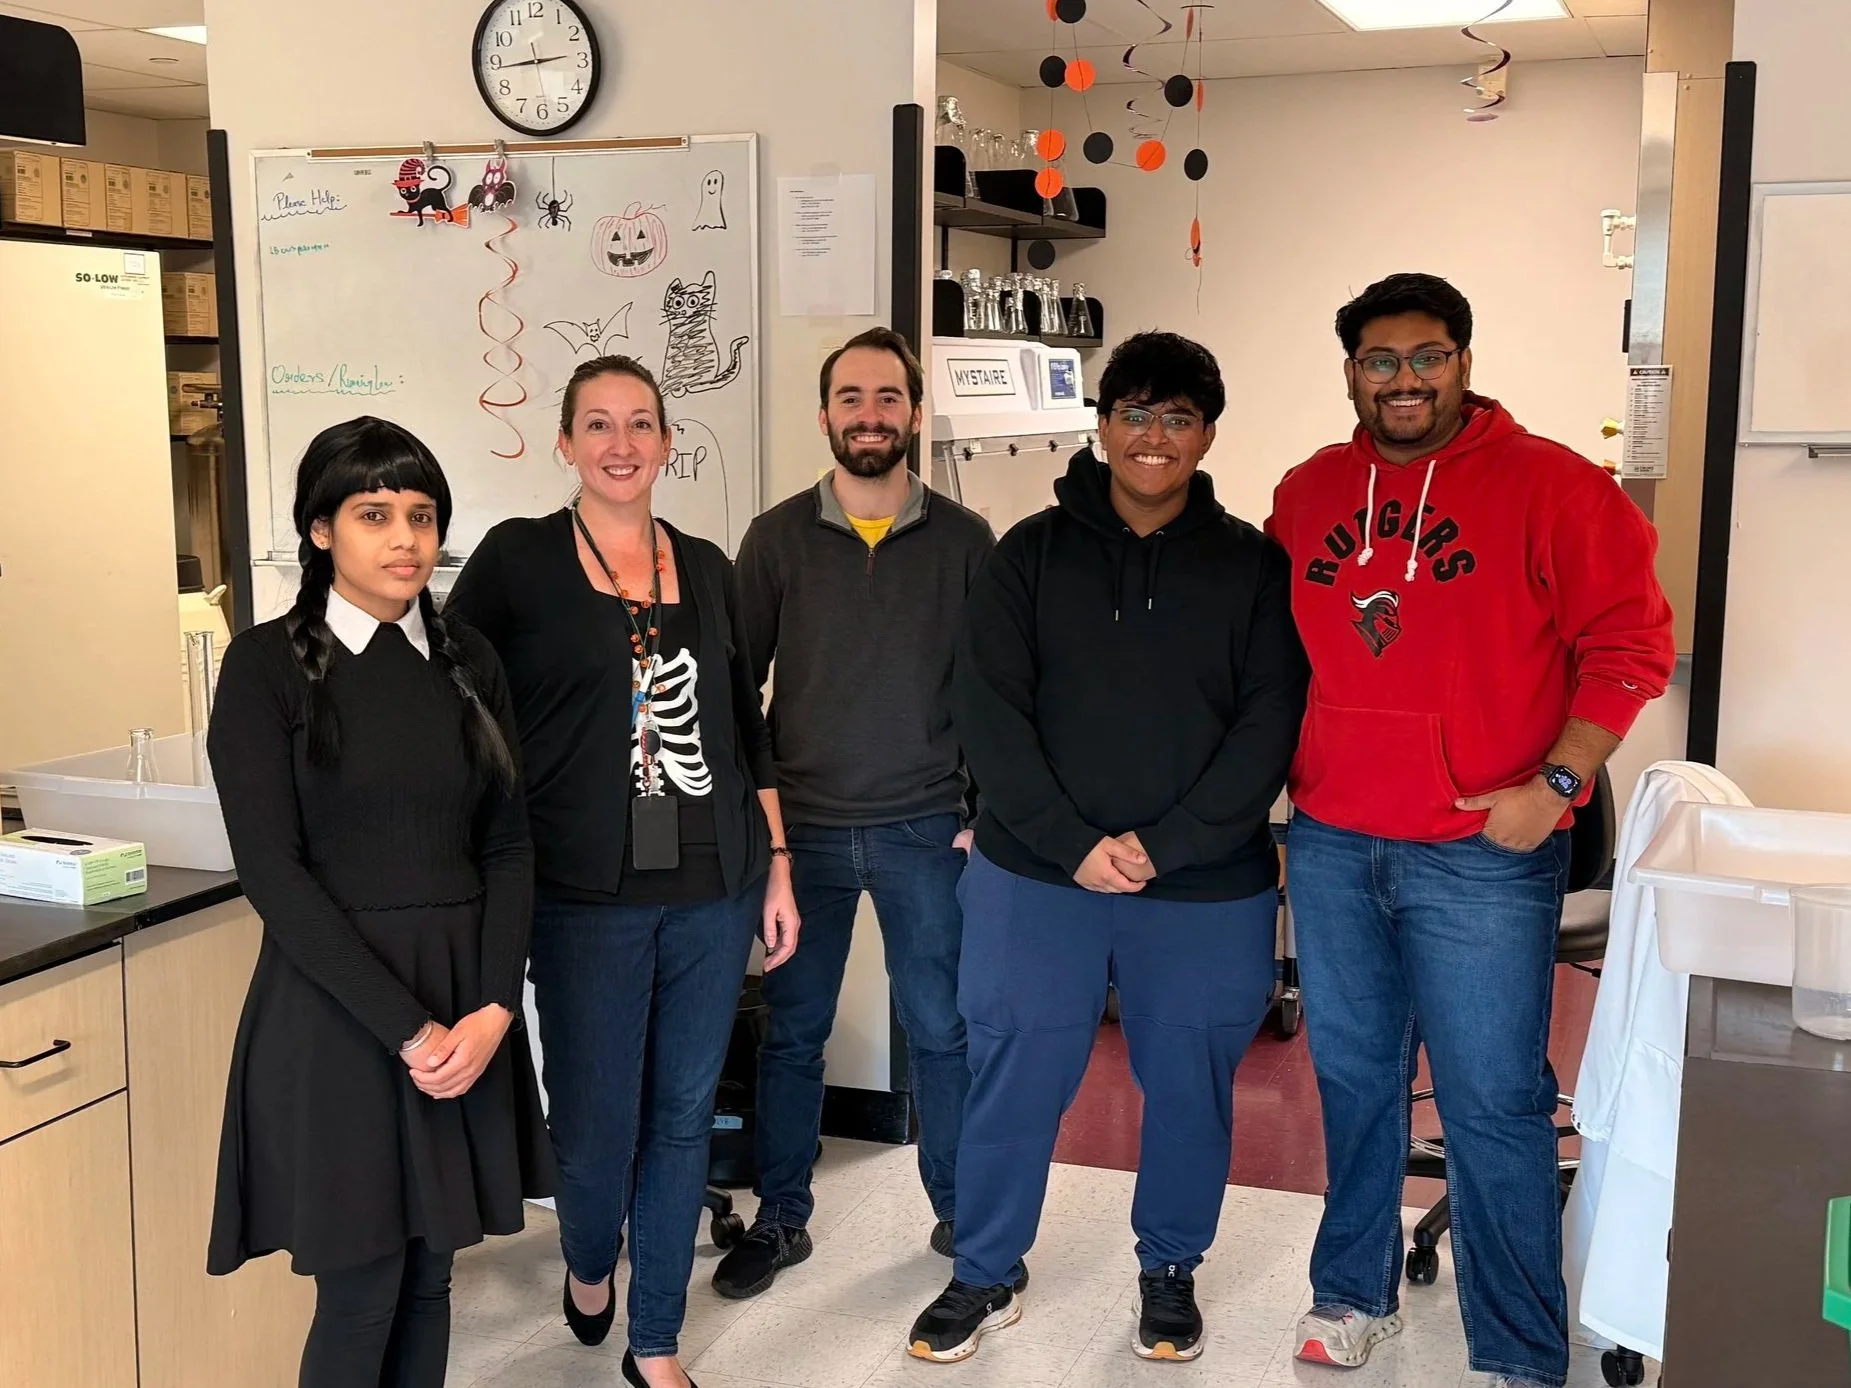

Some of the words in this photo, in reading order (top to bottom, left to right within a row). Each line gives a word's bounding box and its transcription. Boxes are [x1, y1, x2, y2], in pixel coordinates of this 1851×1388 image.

[510, 10, 522, 26] 11
[527, 2, 544, 18] 12
[556, 9, 561, 24] 1
[495, 31, 512, 47] 10
[568, 25, 580, 41] 2
[490, 54, 502, 70] 9
[576, 52, 589, 69] 3
[499, 79, 511, 95] 8
[571, 79, 583, 94] 4
[515, 98, 527, 113] 7
[536, 103, 549, 120] 6
[557, 96, 569, 113] 5
[273, 192, 307, 210] Please
[311, 189, 340, 208] Help:
[954, 369, 1008, 386] MYSTAIRE
[665, 445, 707, 481] RIP
